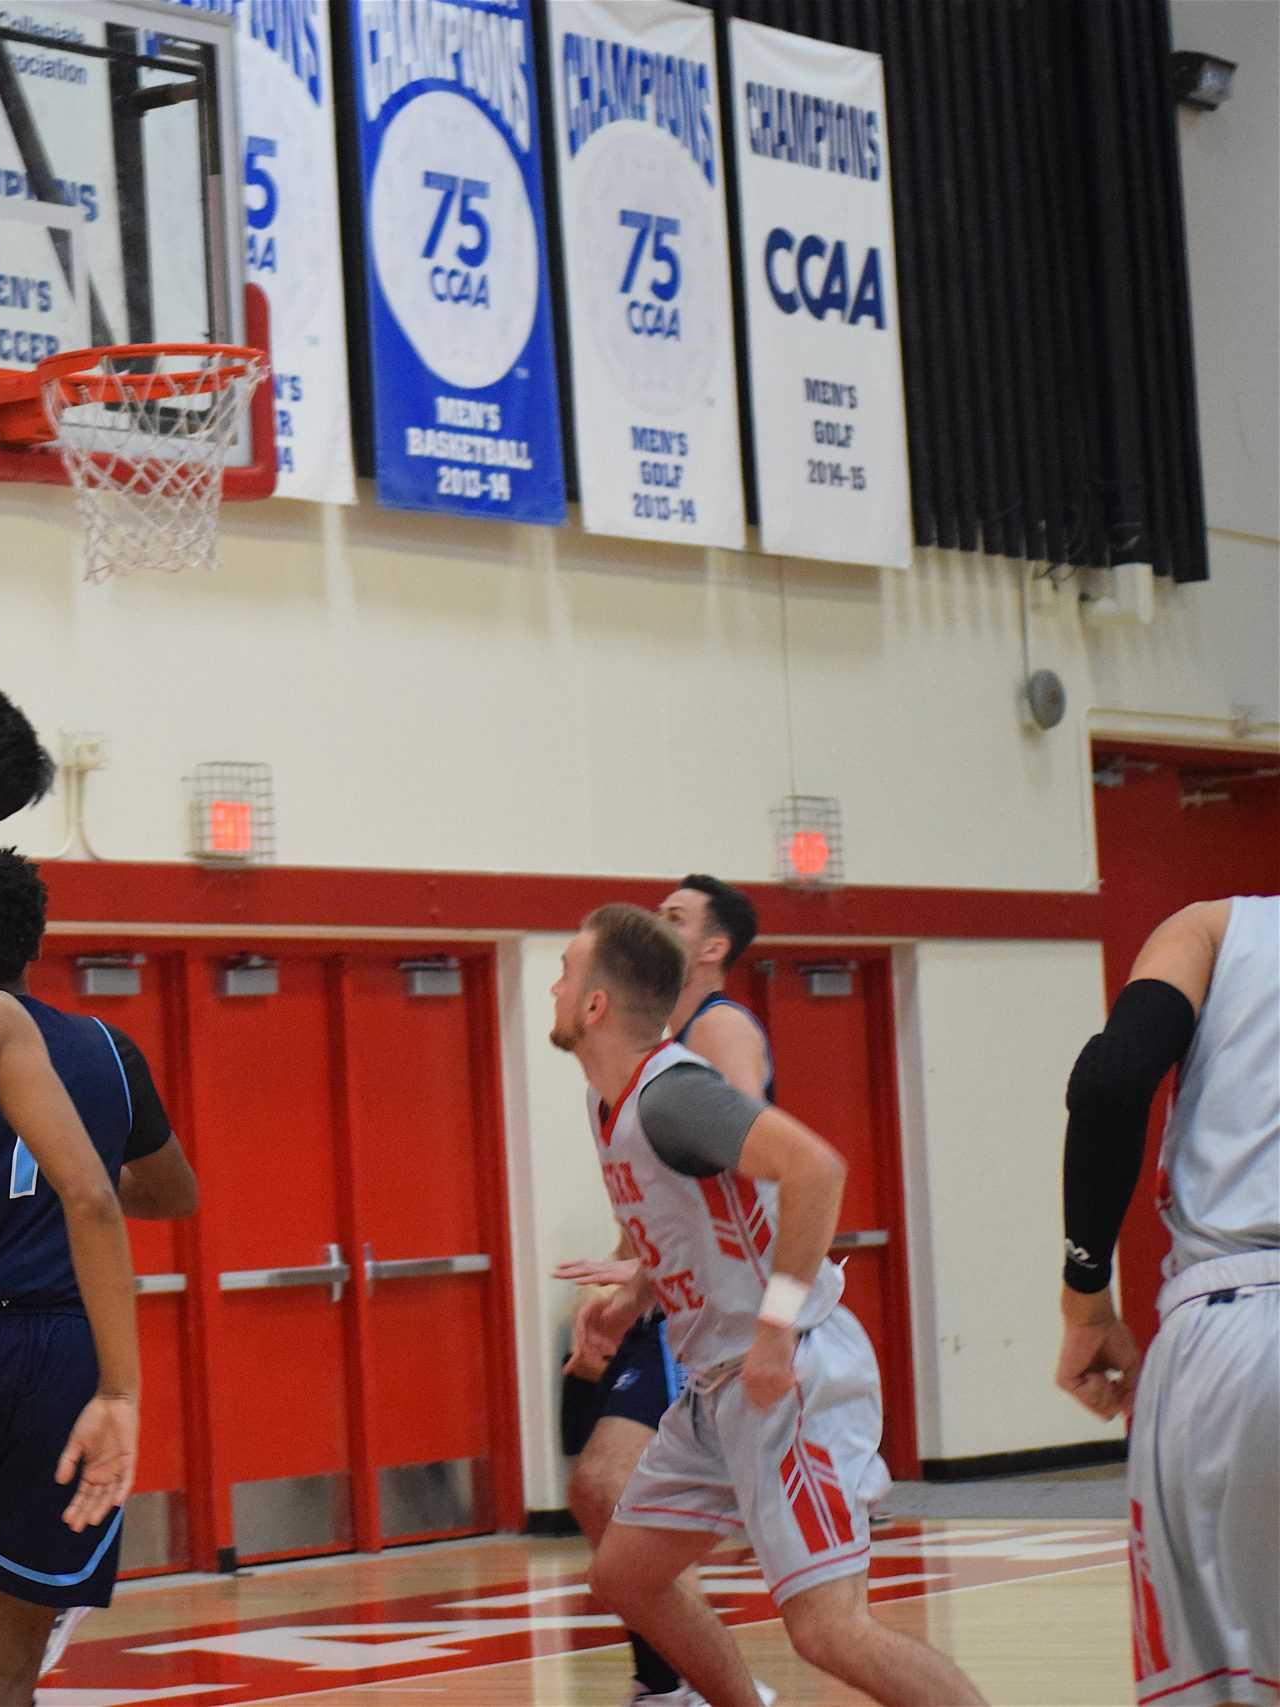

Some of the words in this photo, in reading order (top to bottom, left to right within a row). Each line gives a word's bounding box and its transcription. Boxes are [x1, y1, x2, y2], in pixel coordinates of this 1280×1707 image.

[564, 32, 716, 188] CHAMPIONS
[746, 81, 879, 182] CHAMPIONS
[422, 170, 490, 268] 75
[619, 209, 681, 301] 75
[430, 266, 489, 309] CCAA
[764, 227, 887, 330] CCAA
[626, 300, 681, 341] CCAA
[435, 396, 501, 431] MEN'S
[804, 378, 857, 410] MEN'S
[405, 427, 533, 470] BASKETBALL
[631, 426, 688, 456] MEN'S
[813, 420, 853, 448] GOLF
[640, 460, 683, 489] GOLF
[807, 459, 866, 491] 2014-15
[633, 493, 696, 524] 2013-14
